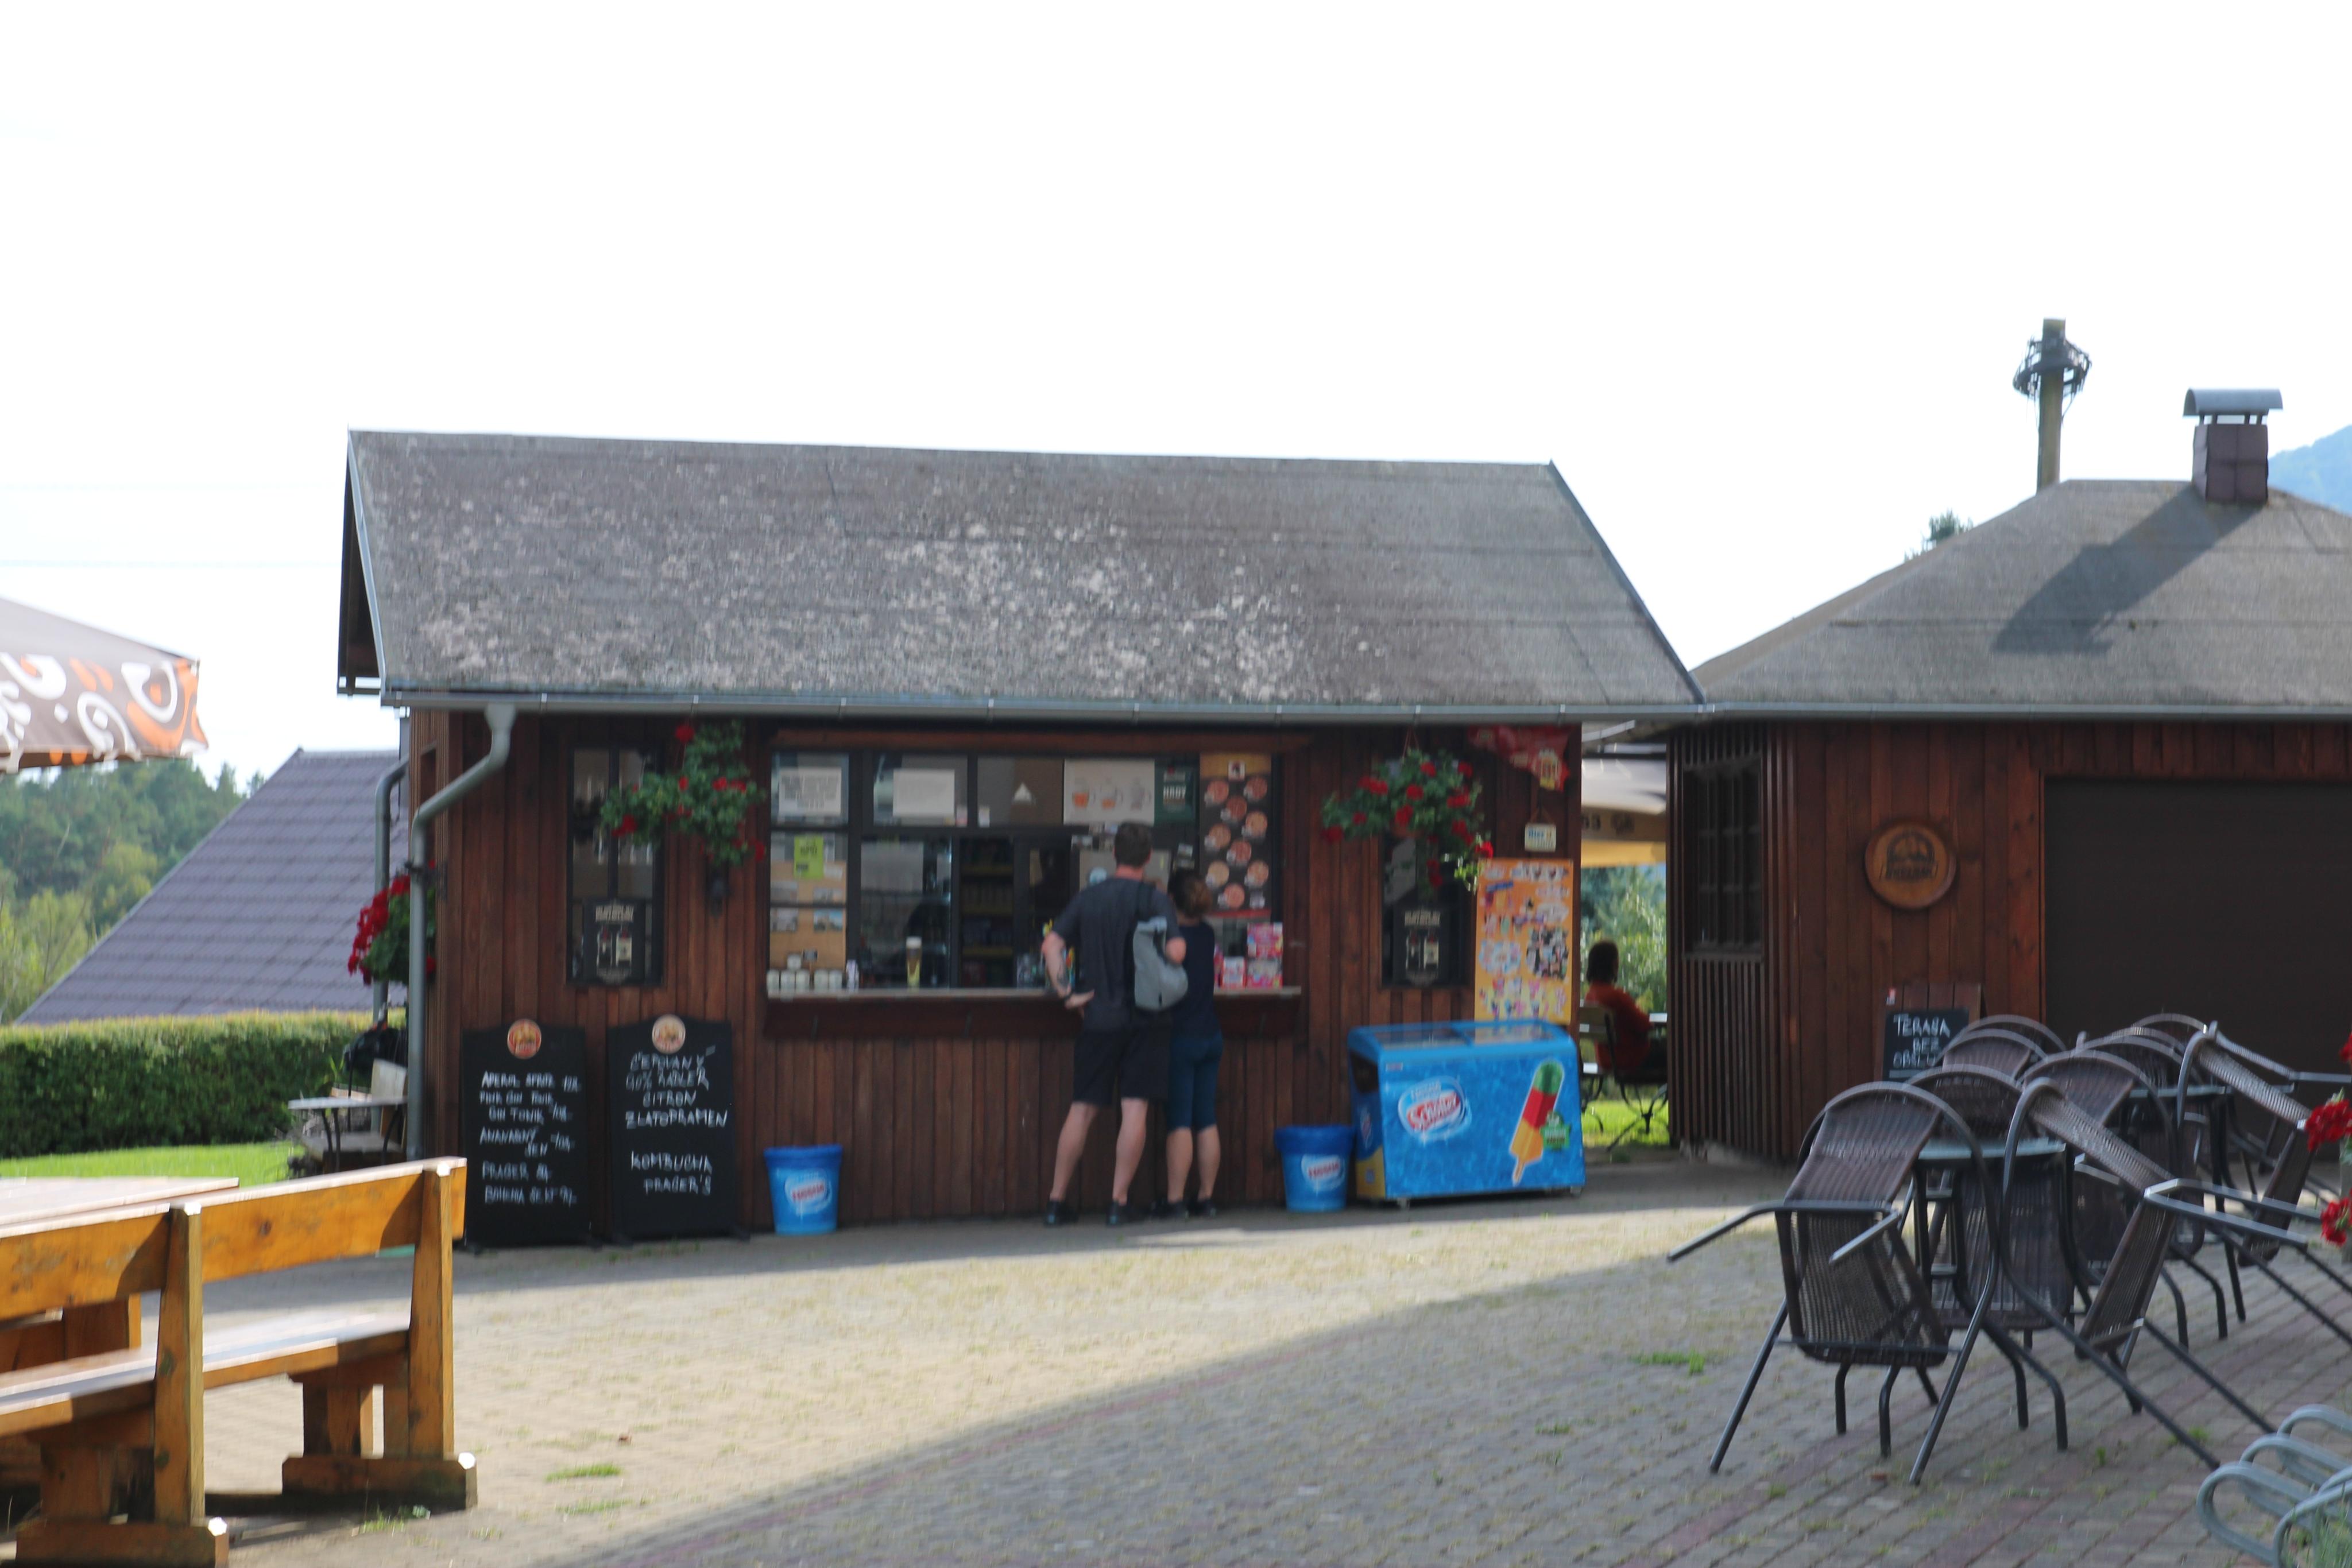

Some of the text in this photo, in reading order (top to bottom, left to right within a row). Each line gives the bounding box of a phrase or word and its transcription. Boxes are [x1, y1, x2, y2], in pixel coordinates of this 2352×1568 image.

[1893, 1013, 1951, 1038] TERASA
[481, 1070, 520, 1089] APEROL
[643, 1089, 697, 1108] CITRON
[489, 1104, 506, 1122] GIN
[510, 1106, 545, 1126] TONIK
[625, 1108, 728, 1130] ZLATOPRAMEN
[482, 1160, 529, 1183] PRAGER
[632, 1150, 713, 1175] KOMBUCHA
[485, 1184, 525, 1205] BOHEMIA
[644, 1174, 711, 1197] PRAGER'S
